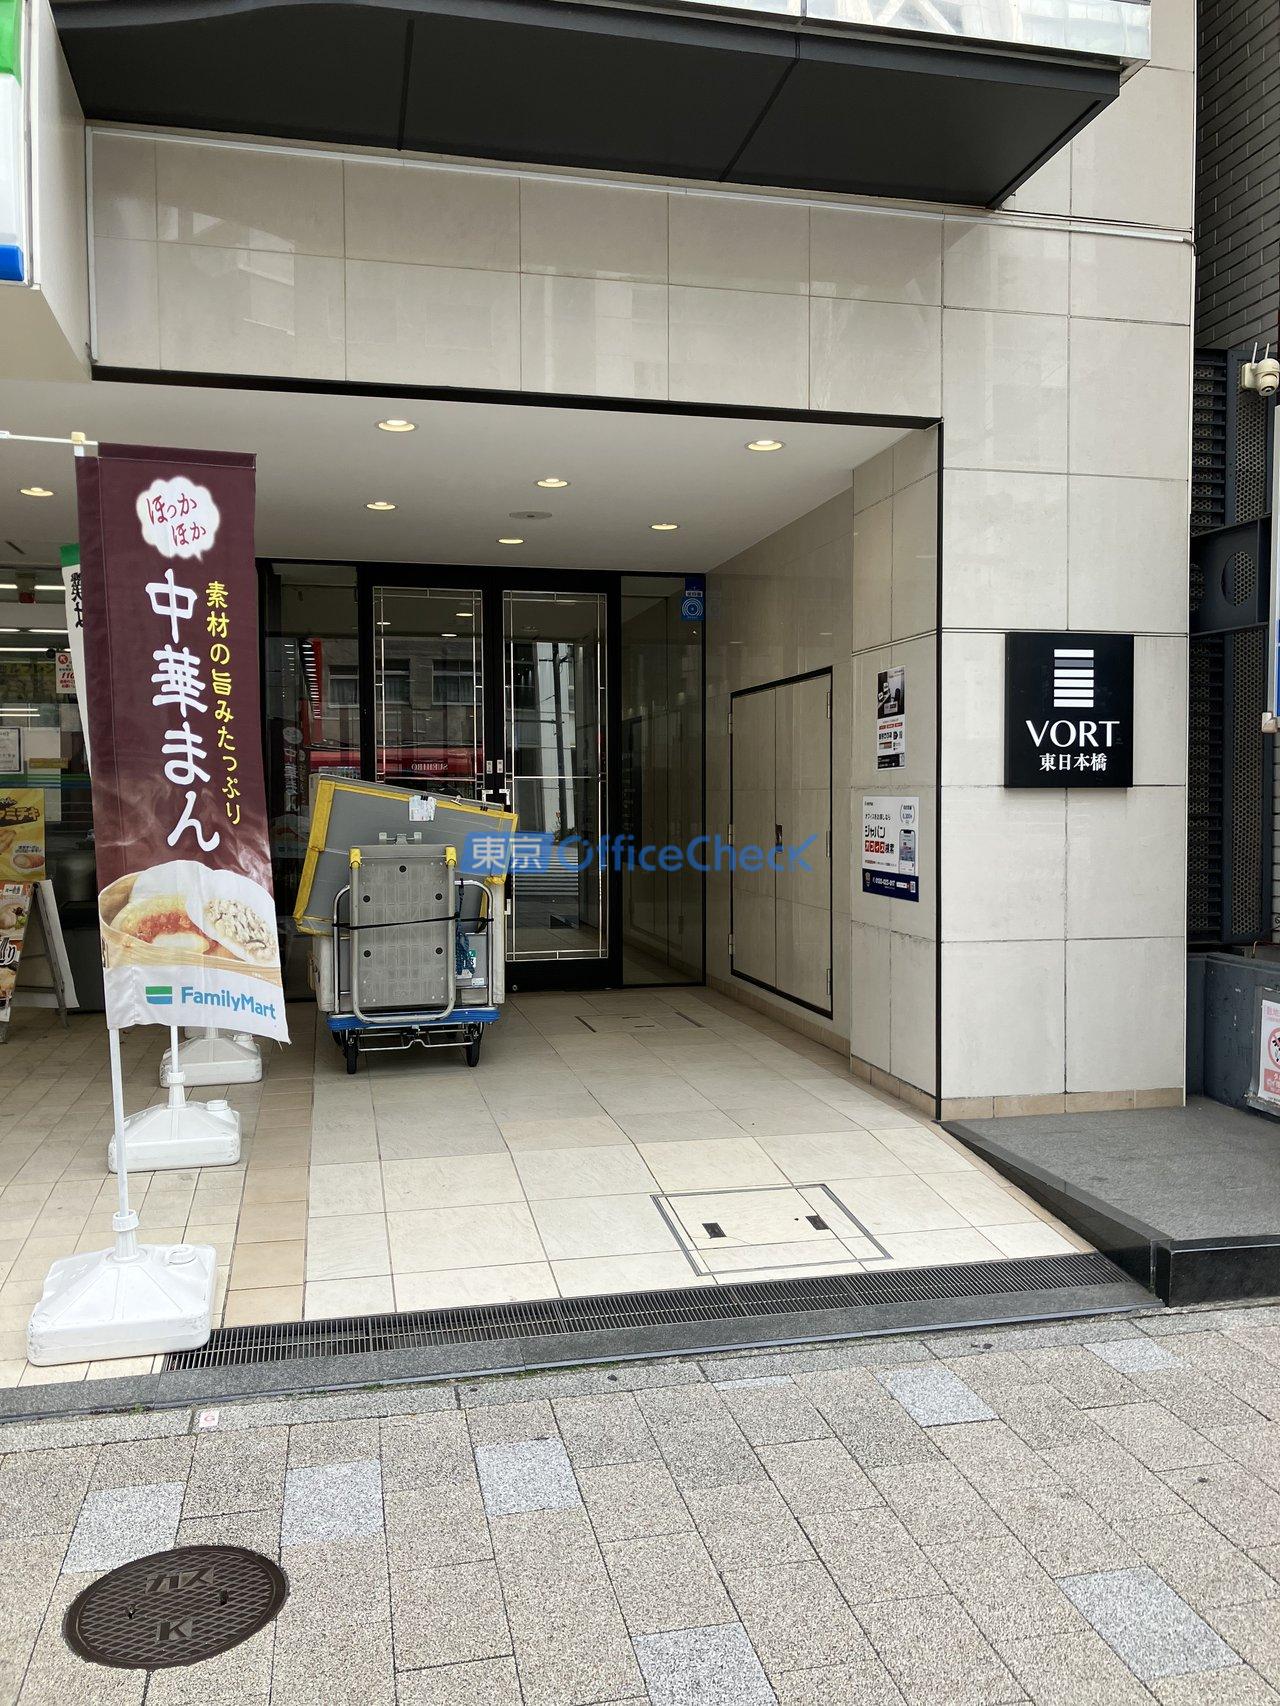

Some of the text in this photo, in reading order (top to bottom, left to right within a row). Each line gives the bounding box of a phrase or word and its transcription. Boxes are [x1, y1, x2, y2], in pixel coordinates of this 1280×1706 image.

[146, 493, 197, 525] ほっか
[171, 521, 206, 546] ほか
[145, 568, 220, 852] 中華まん
[205, 580, 241, 825] 素材の旨みたっぷり
[1025, 720, 1120, 747] VORT
[1040, 753, 1107, 771] 東日本橋
[864, 825, 886, 838] ジャパン
[181, 986, 276, 1020] FamilyMart
